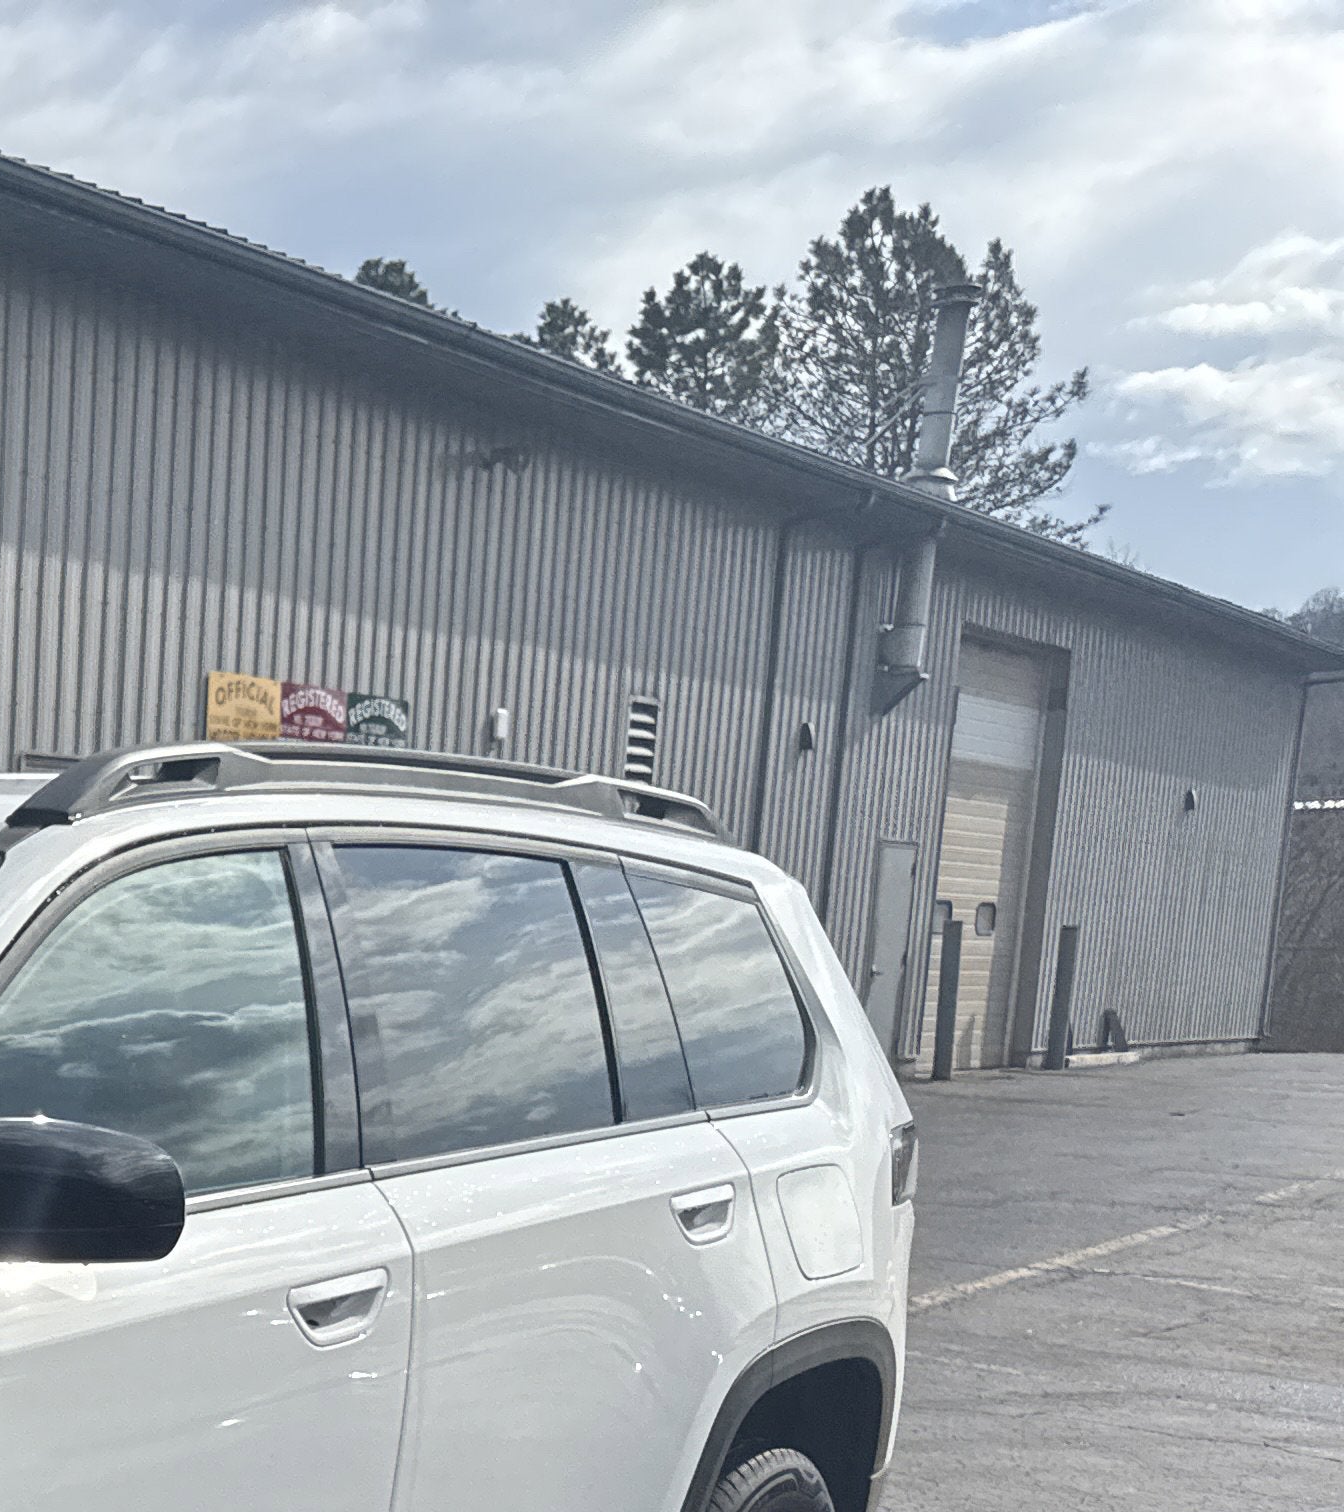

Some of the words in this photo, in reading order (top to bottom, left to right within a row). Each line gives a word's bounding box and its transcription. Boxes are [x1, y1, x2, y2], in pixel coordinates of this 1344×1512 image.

[215, 680, 275, 715] OFFICIAL
[282, 689, 344, 723] REGISTERED
[348, 699, 406, 731] REGISTERED
